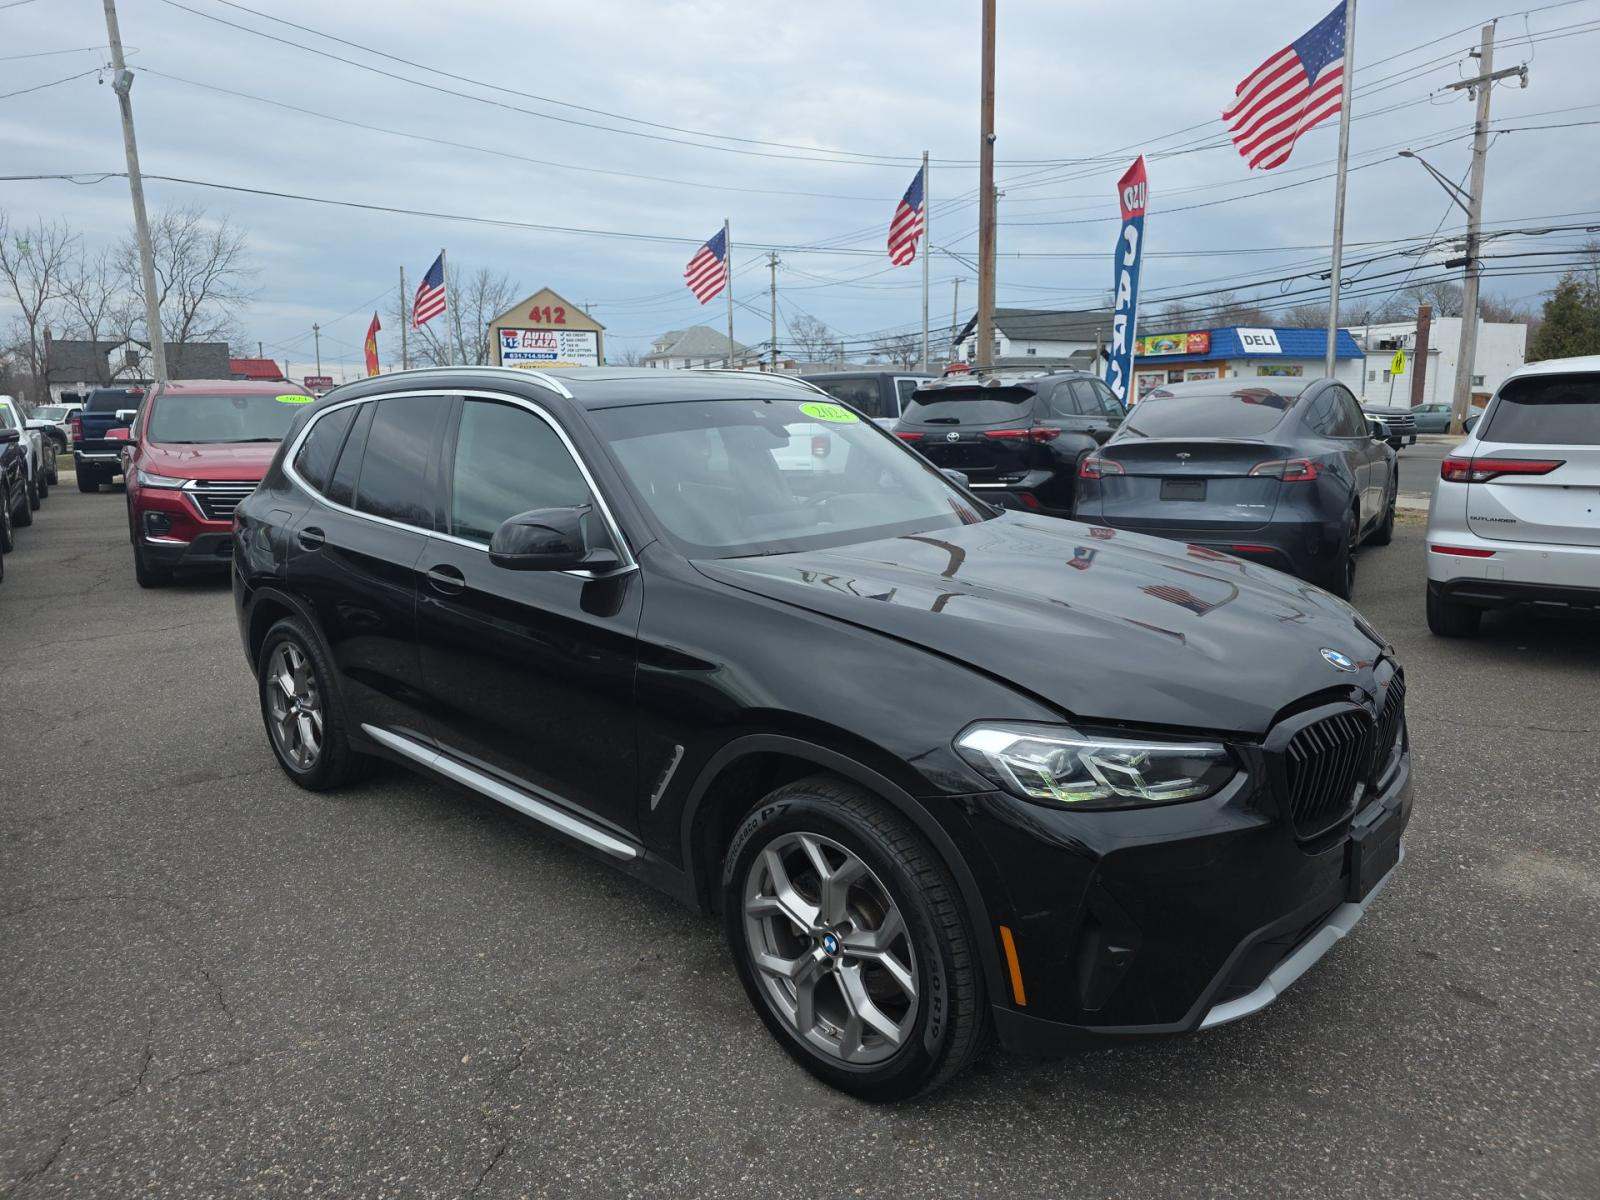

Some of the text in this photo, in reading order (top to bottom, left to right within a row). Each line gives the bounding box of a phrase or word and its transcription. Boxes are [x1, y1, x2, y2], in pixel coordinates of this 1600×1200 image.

[529, 306, 566, 324] 412
[524, 331, 553, 339] AUTO
[1244, 335, 1275, 346] DELI
[502, 337, 519, 348] 112
[523, 339, 557, 348] PLAZA
[1470, 515, 1516, 523] OUTLANDER
[762, 803, 793, 821] P7
